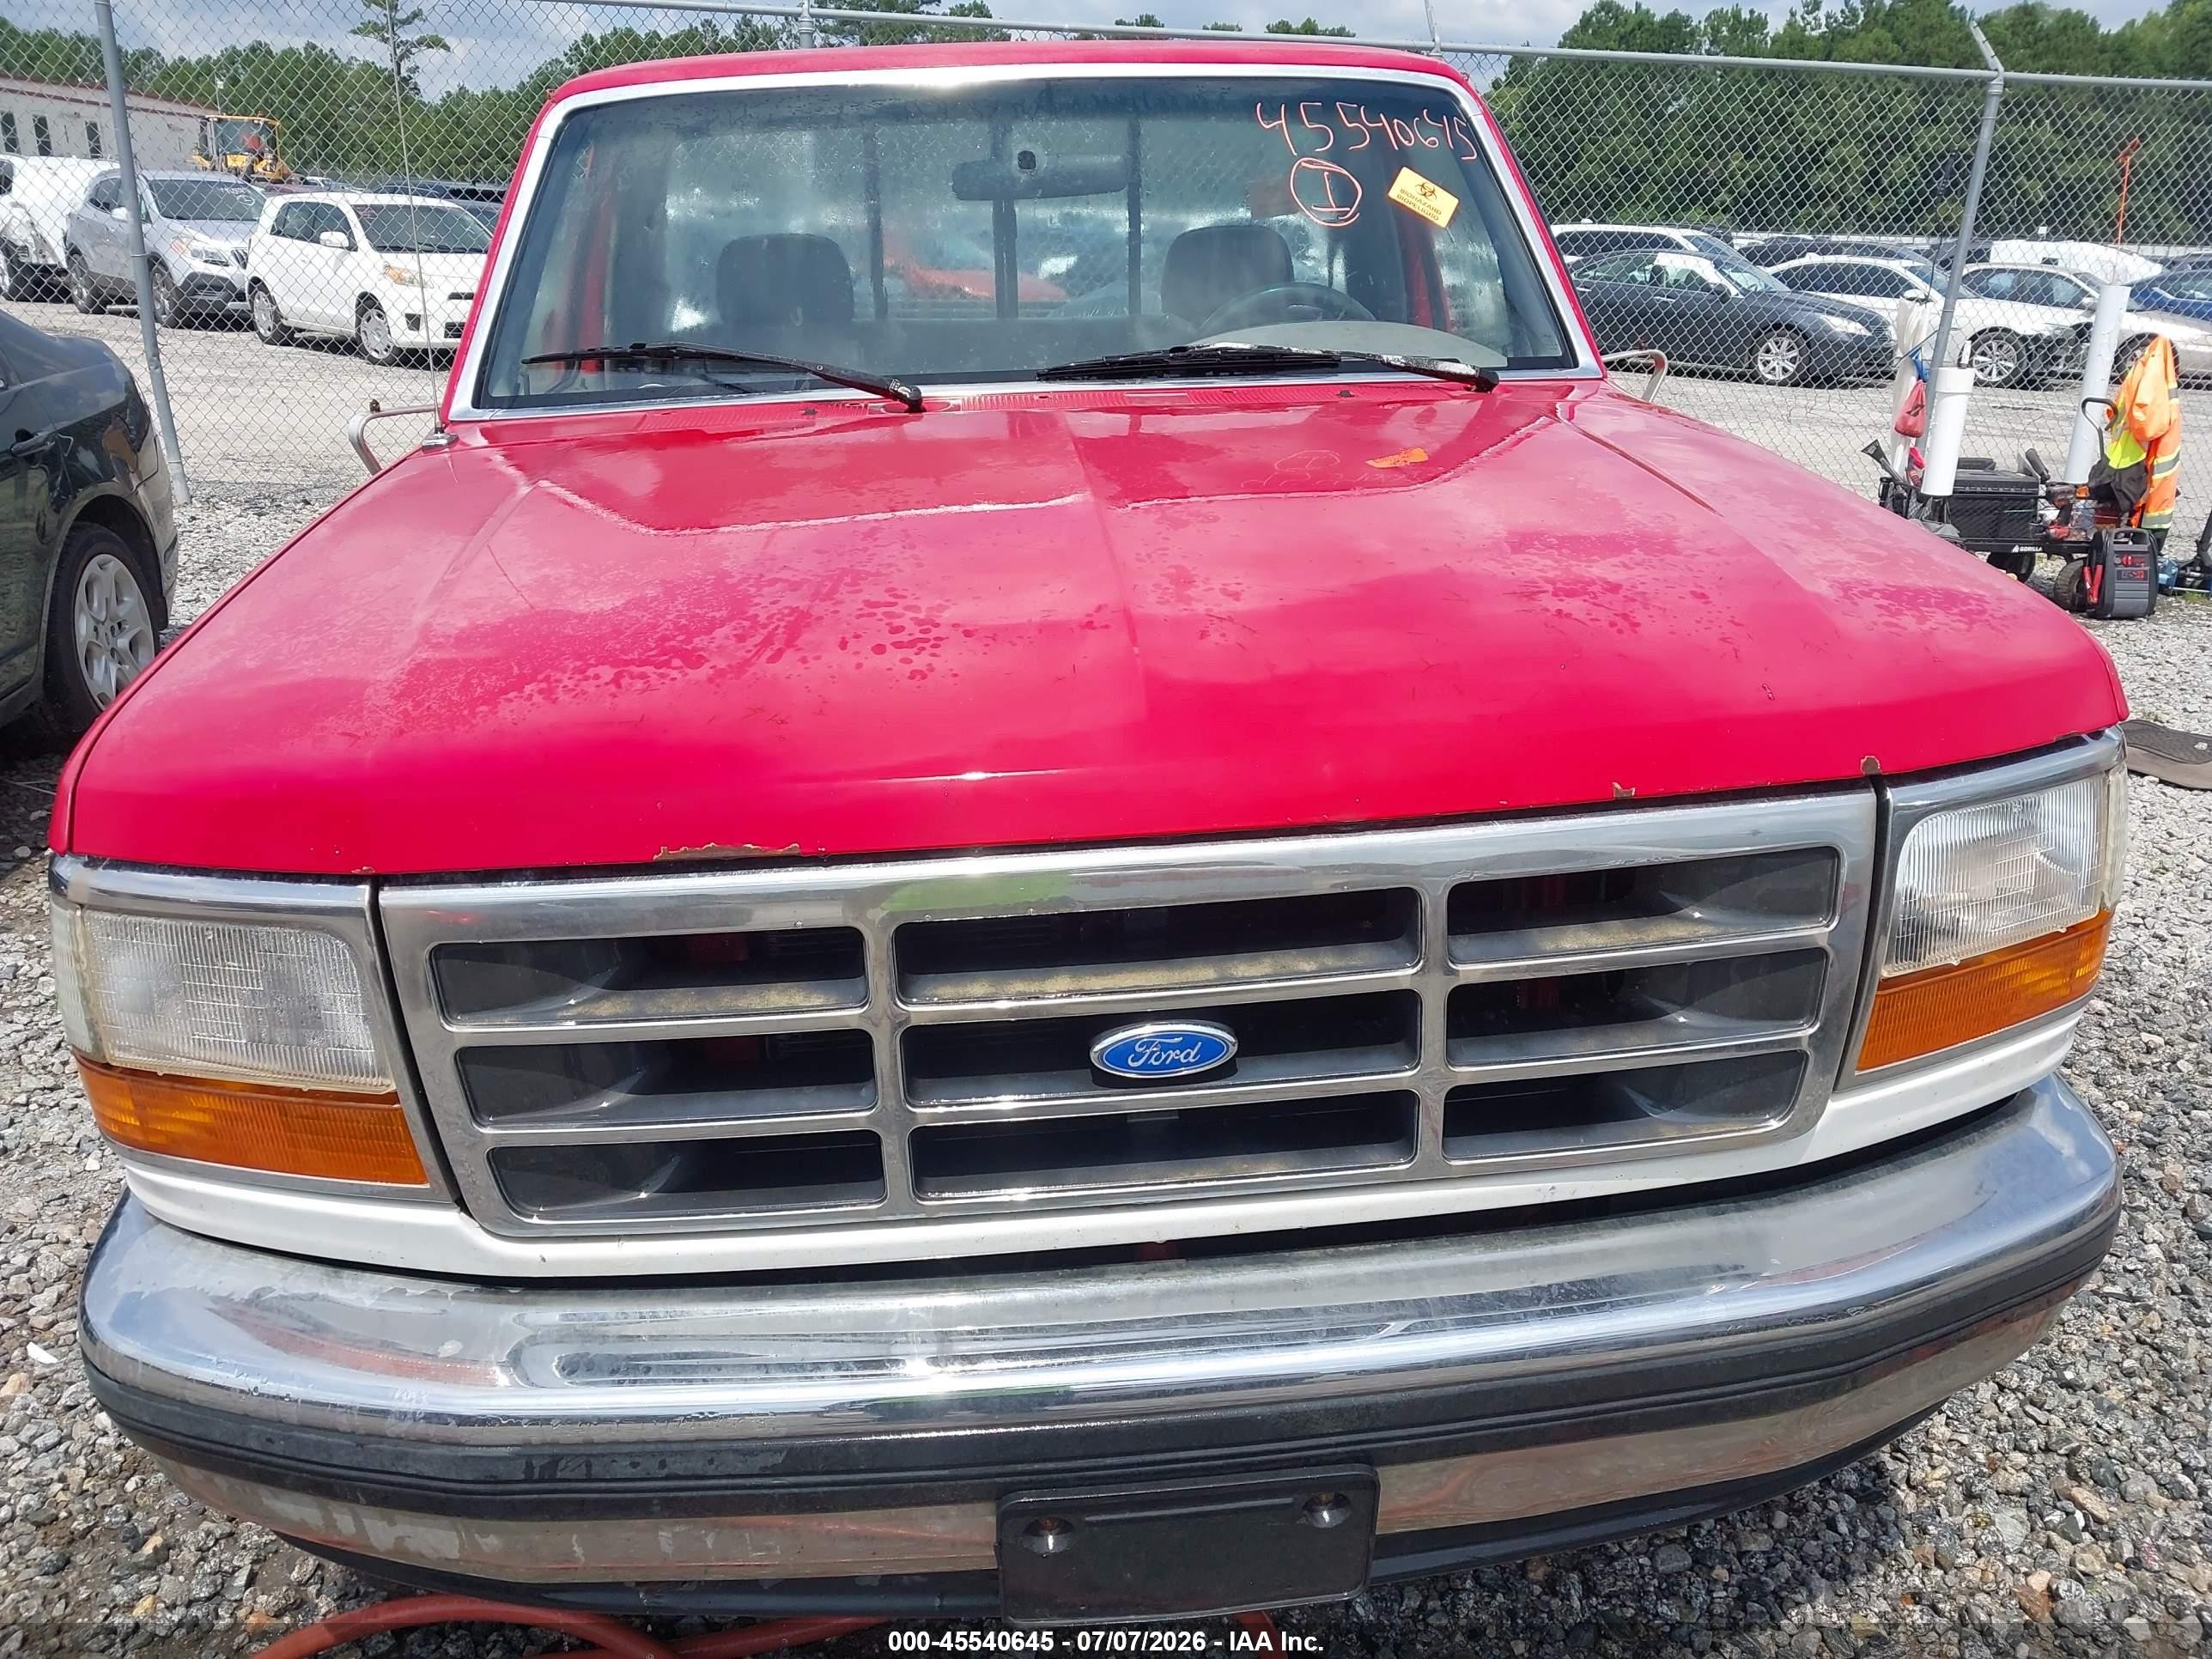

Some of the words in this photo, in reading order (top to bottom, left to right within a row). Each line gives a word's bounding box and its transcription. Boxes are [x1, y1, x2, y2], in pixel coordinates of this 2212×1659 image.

[1256, 102, 1478, 161] 45540645
[1400, 188, 1442, 215] BIOHAZARD
[1127, 1036, 1202, 1067] Ford
